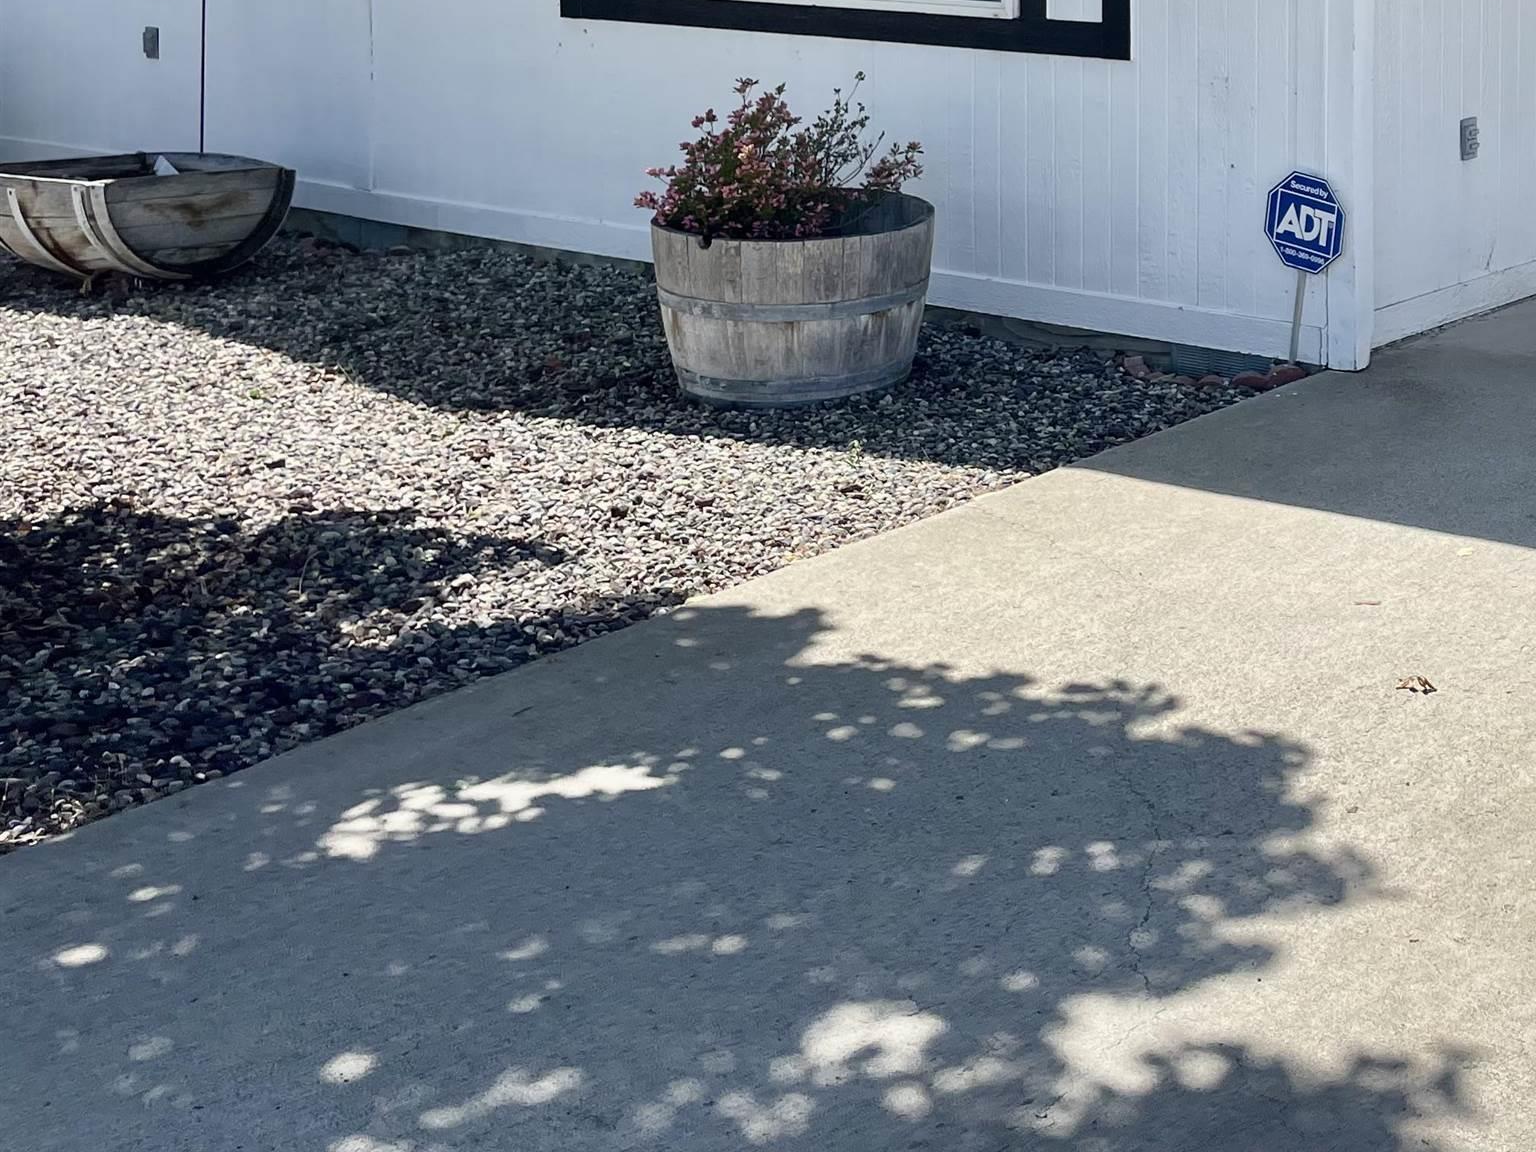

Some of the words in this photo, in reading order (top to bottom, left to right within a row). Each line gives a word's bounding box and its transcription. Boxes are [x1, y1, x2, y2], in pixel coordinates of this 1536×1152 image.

[1290, 180, 1319, 195] Secured
[1319, 188, 1329, 199] by
[1276, 202, 1336, 247] ADT
